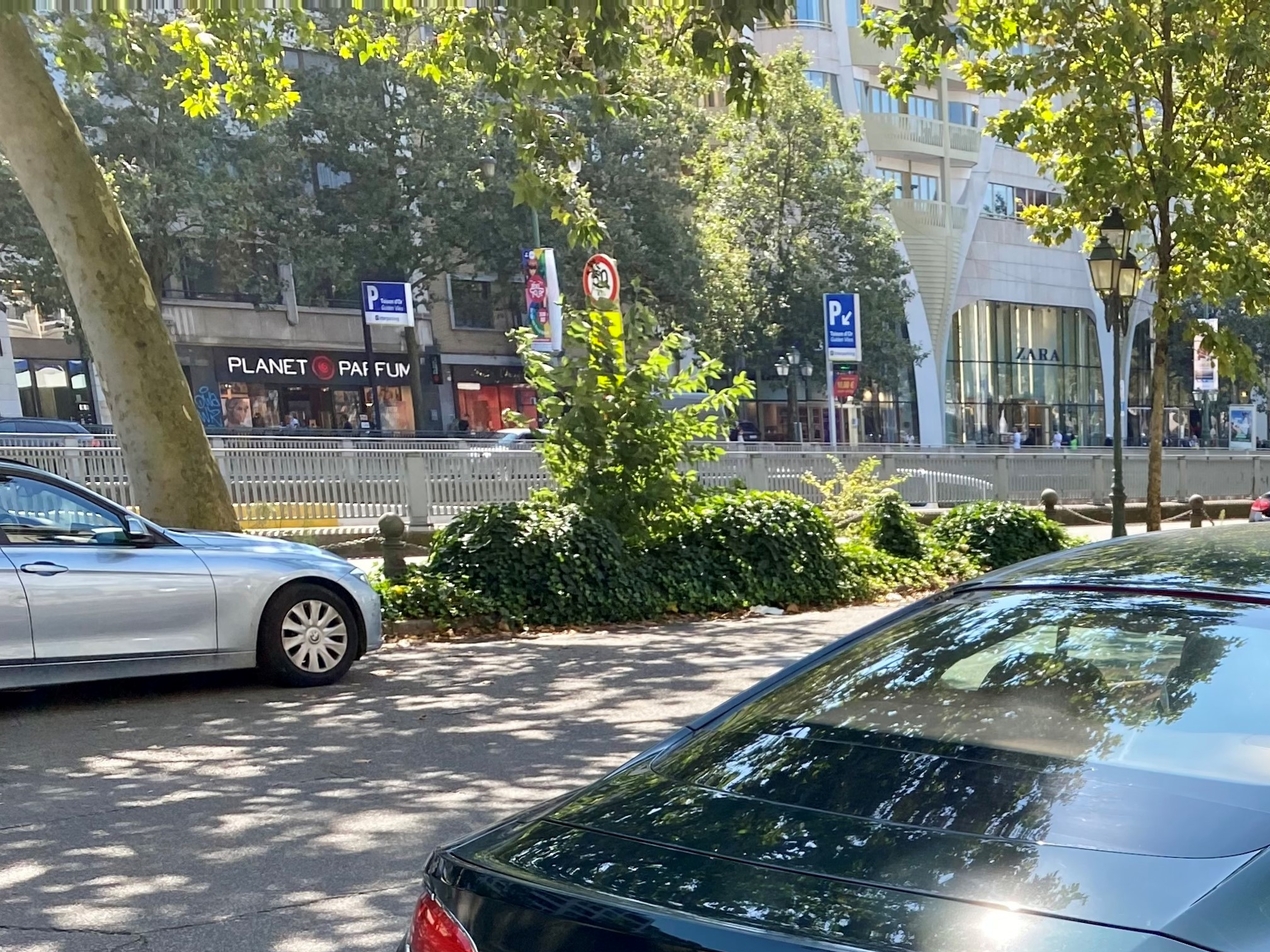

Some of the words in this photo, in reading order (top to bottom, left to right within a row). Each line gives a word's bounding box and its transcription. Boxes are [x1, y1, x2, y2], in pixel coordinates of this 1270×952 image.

[366, 285, 379, 310] P
[828, 300, 842, 326] P
[1015, 346, 1060, 362] ZARA
[227, 356, 308, 376] PLANET
